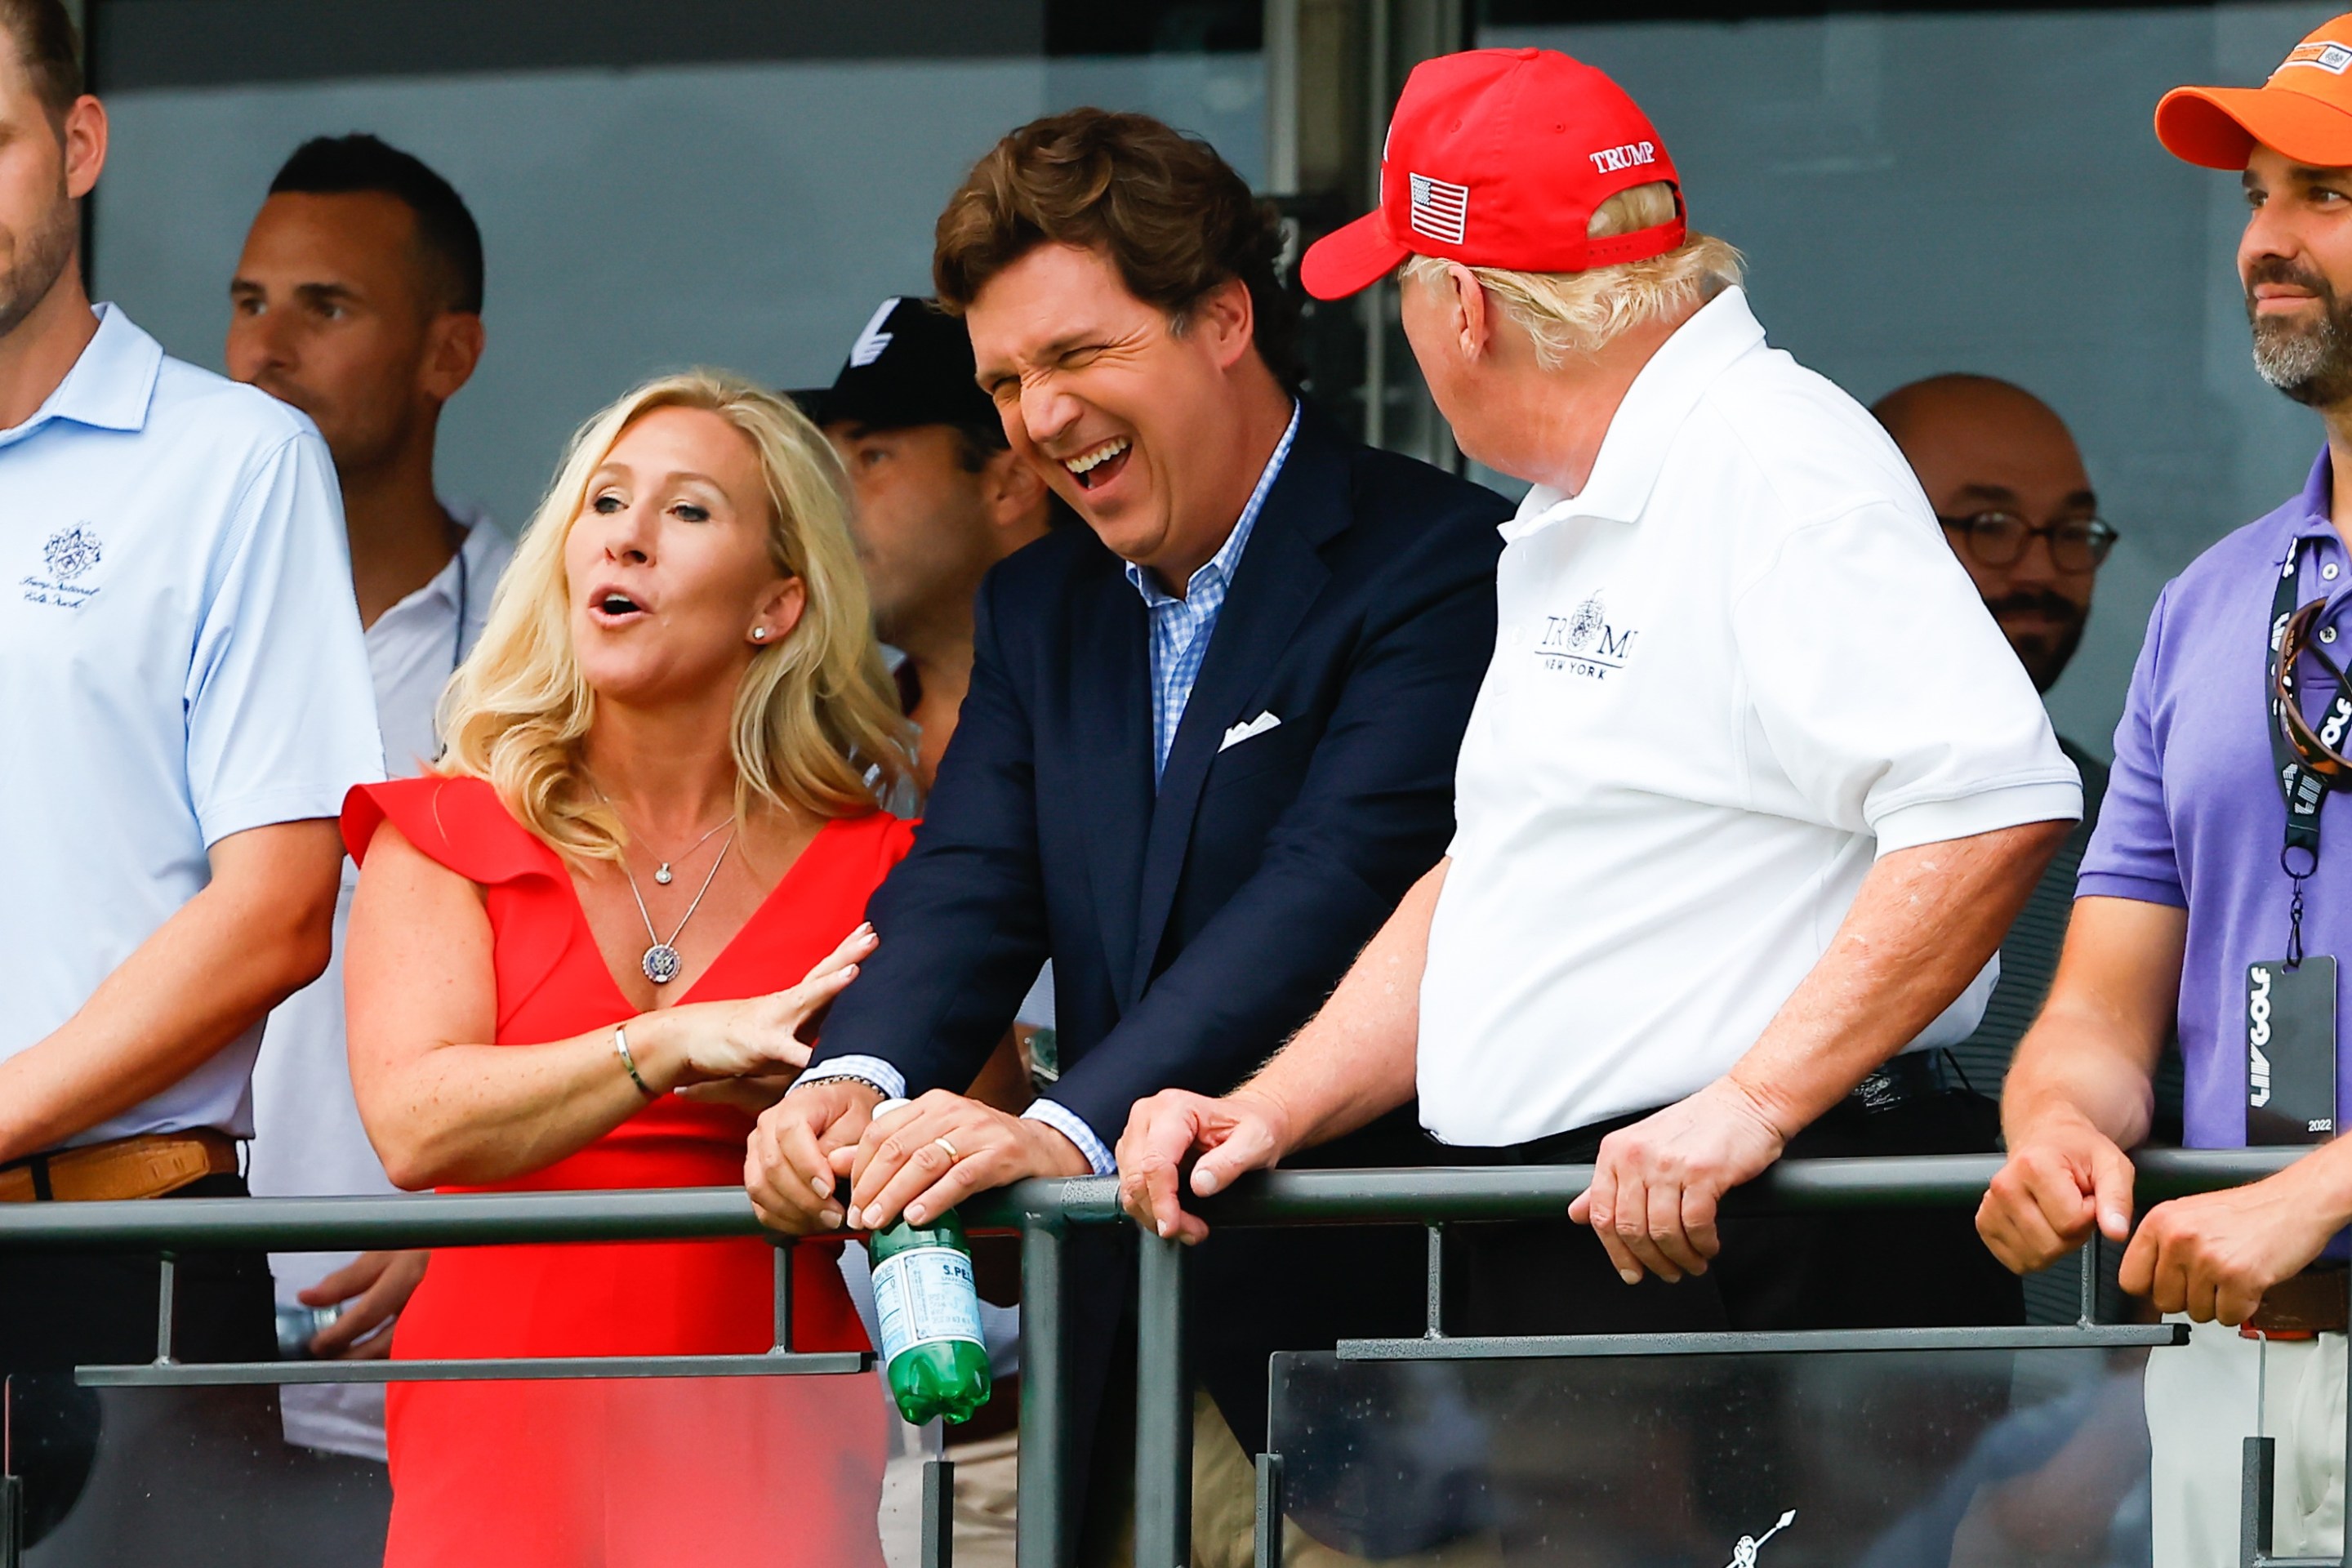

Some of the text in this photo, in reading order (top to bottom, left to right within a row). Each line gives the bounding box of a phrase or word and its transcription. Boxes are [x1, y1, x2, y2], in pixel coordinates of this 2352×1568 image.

[1588, 140, 1655, 174] TRUMP
[1544, 658, 1608, 681] NEW YORK
[2320, 697, 2352, 750] OLF
[2250, 967, 2271, 1108] LIV GOLF
[2308, 1119, 2332, 1132] 2022
